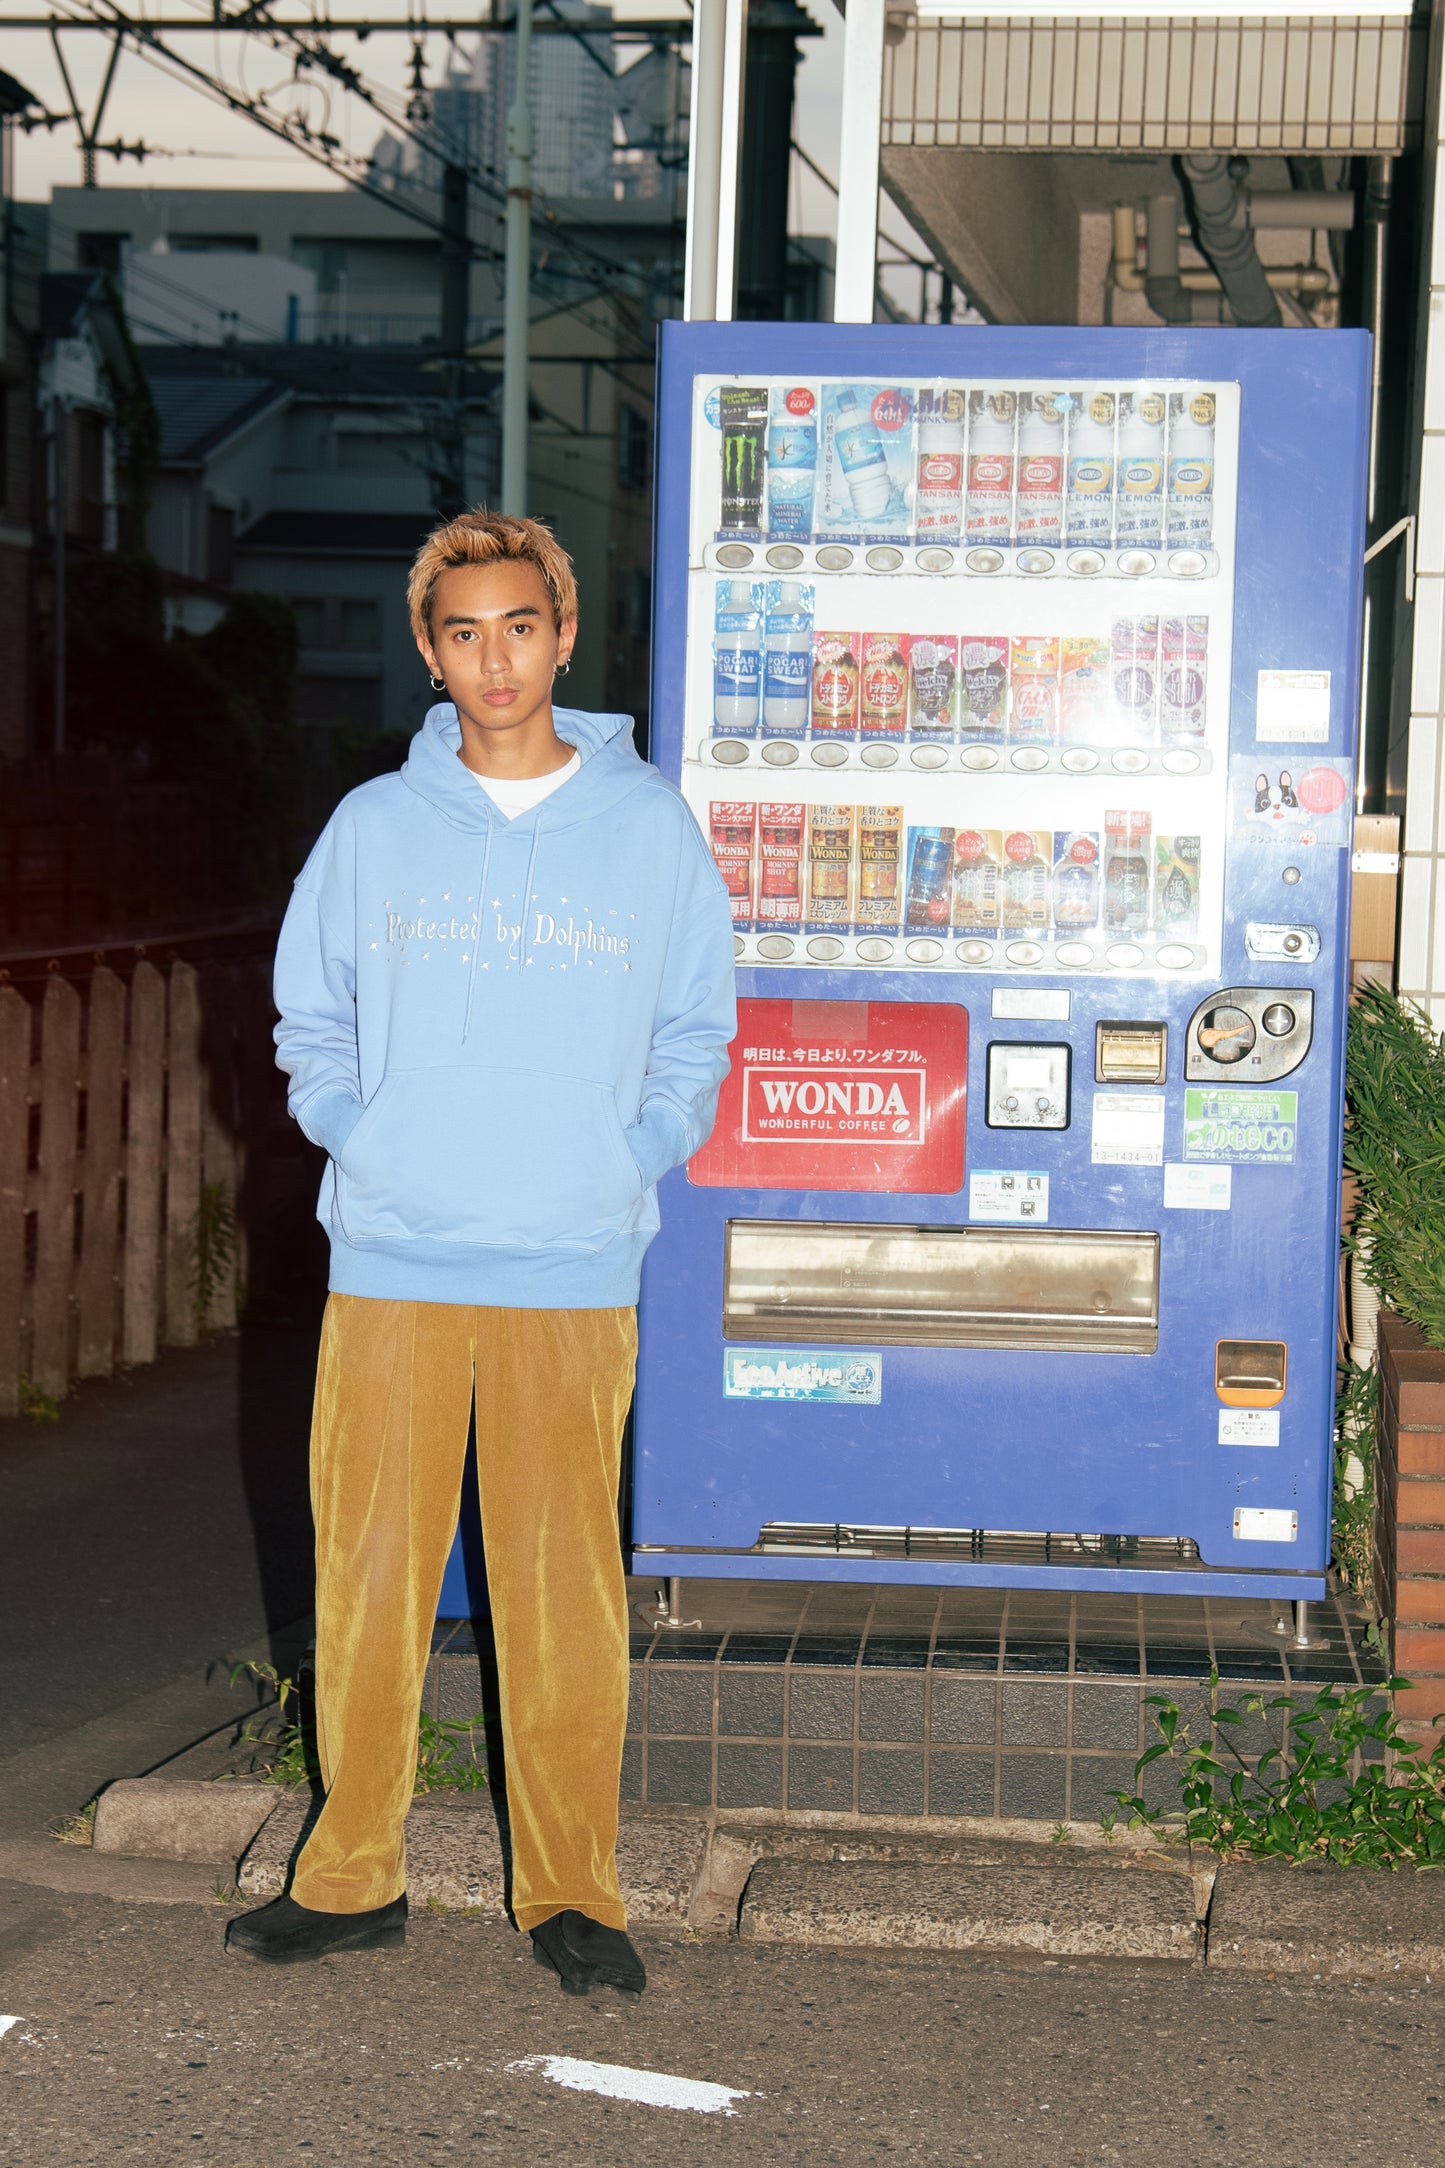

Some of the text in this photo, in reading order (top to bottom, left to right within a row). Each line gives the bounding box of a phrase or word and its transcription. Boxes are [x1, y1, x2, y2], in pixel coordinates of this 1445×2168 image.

[919, 491, 960, 499] TANSAN
[969, 492, 1010, 500] TANSAN
[1019, 493, 1060, 501] TANSAN
[1068, 494, 1111, 503] LEMON
[1118, 494, 1161, 503] LEMON
[1168, 494, 1211, 503] LEMON
[718, 655, 758, 665] POCARI
[767, 656, 808, 666] POCARI
[767, 666, 805, 675] SWEAT
[915, 675, 946, 687] Welch's
[966, 675, 997, 688] Welch's
[1122, 671, 1146, 684] CAPIS
[1171, 671, 1197, 684] CAPIS
[811, 815, 851, 826] 香りとコク
[860, 816, 900, 826] 香りとコク
[713, 843, 750, 857] WONDA
[762, 844, 799, 858] WONDA
[812, 846, 848, 859] WONDA
[862, 847, 896, 860] WONDA
[717, 859, 748, 867] MORNING
[767, 860, 797, 868] MORNING
[767, 868, 786, 876] SHOT
[760, 898, 800, 918] 朝専用
[809, 900, 848, 911] プレミアム
[859, 901, 897, 911] プレミアム
[386, 911, 631, 966] Protected by Dolphins
[743, 1047, 928, 1064] 明日は、今日より、ワンダフル。
[760, 1081, 909, 1116] WONDA
[758, 1118, 886, 1131] WONDERFUL COFFEE
[1095, 1151, 1159, 1162] 13-1434-01
